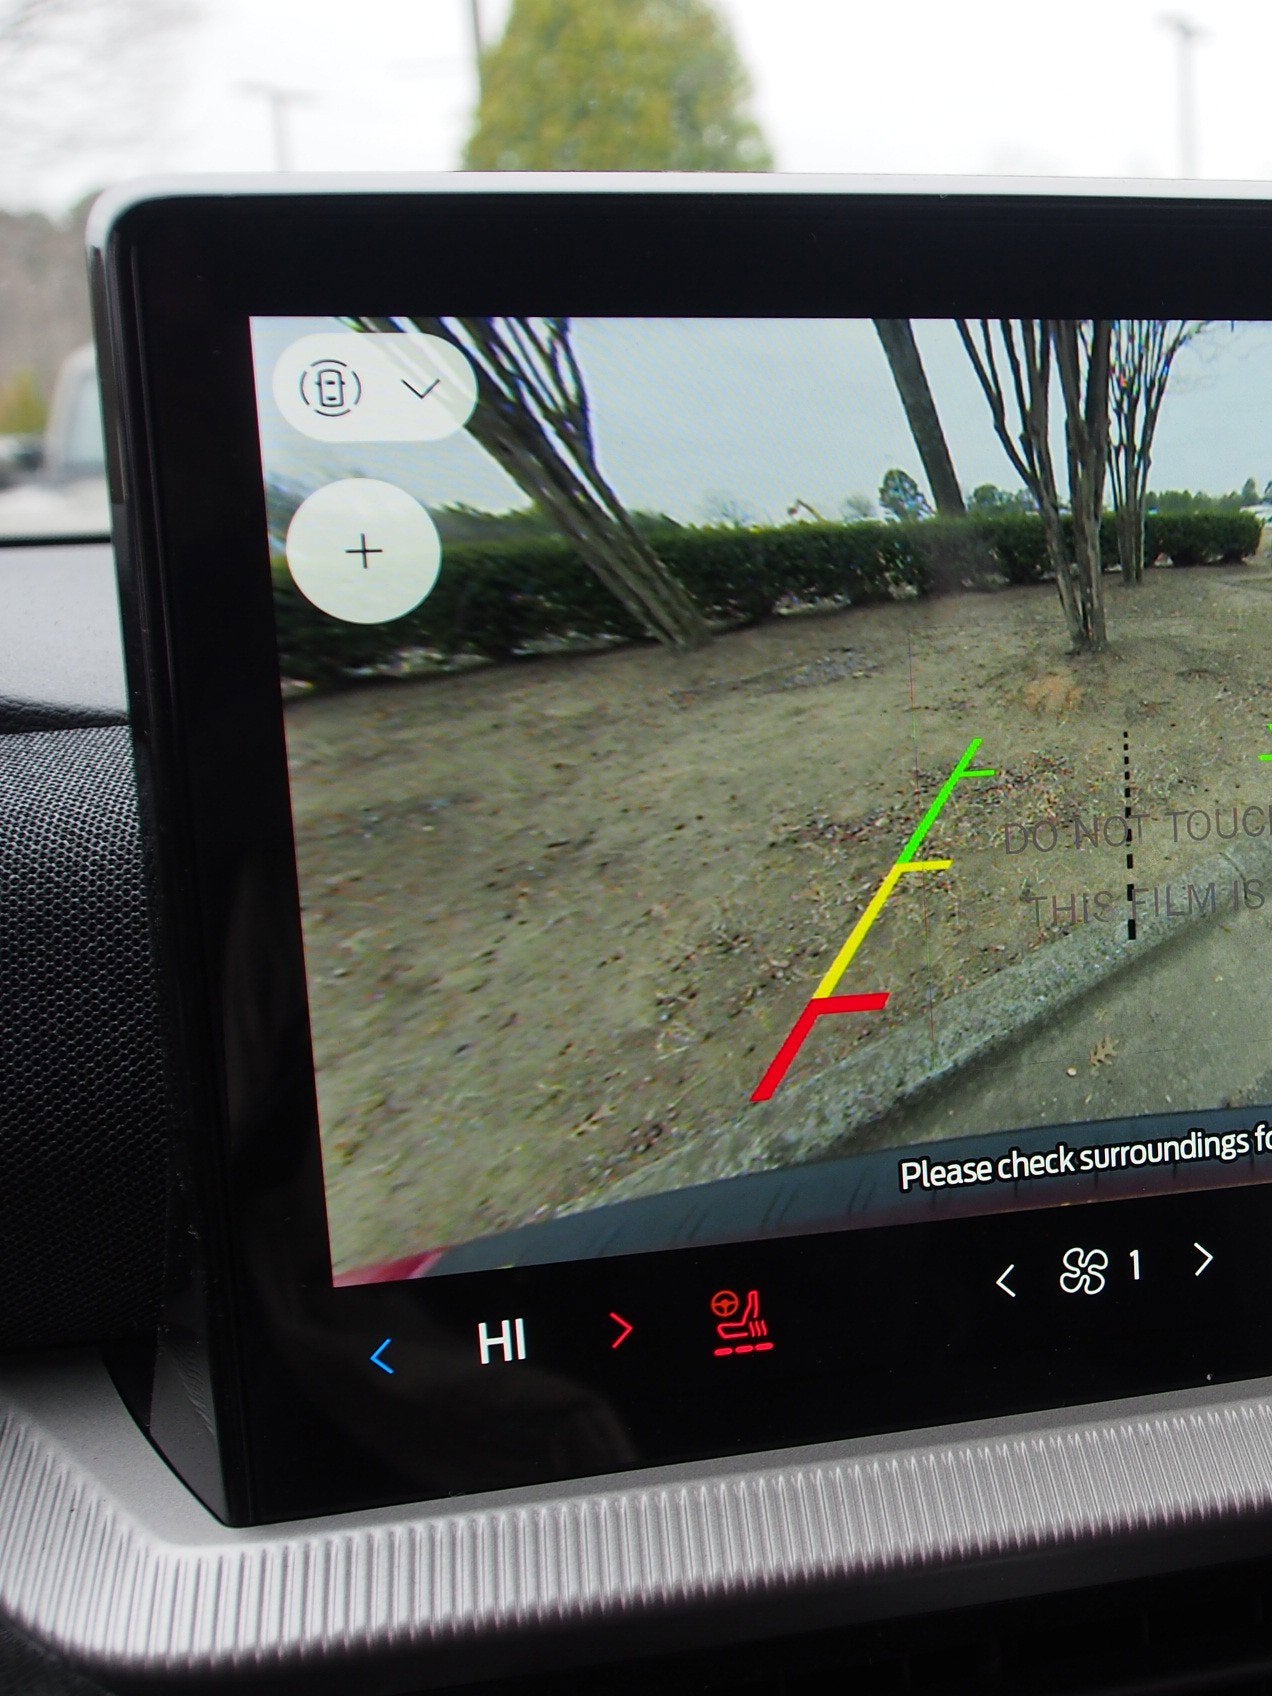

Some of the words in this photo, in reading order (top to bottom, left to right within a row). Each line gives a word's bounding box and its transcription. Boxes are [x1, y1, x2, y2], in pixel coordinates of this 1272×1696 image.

[1004, 819, 1059, 855] DO
[1074, 812, 1149, 850] NOT
[1026, 889, 1117, 927] THIS
[1131, 882, 1216, 920] FILM
[1233, 878, 1266, 911] IS
[901, 1160, 993, 1191] Please
[997, 1145, 1076, 1180] check
[1079, 1130, 1250, 1171] surroundings
[1129, 1249, 1140, 1281] 1
[477, 1317, 527, 1365] HI
